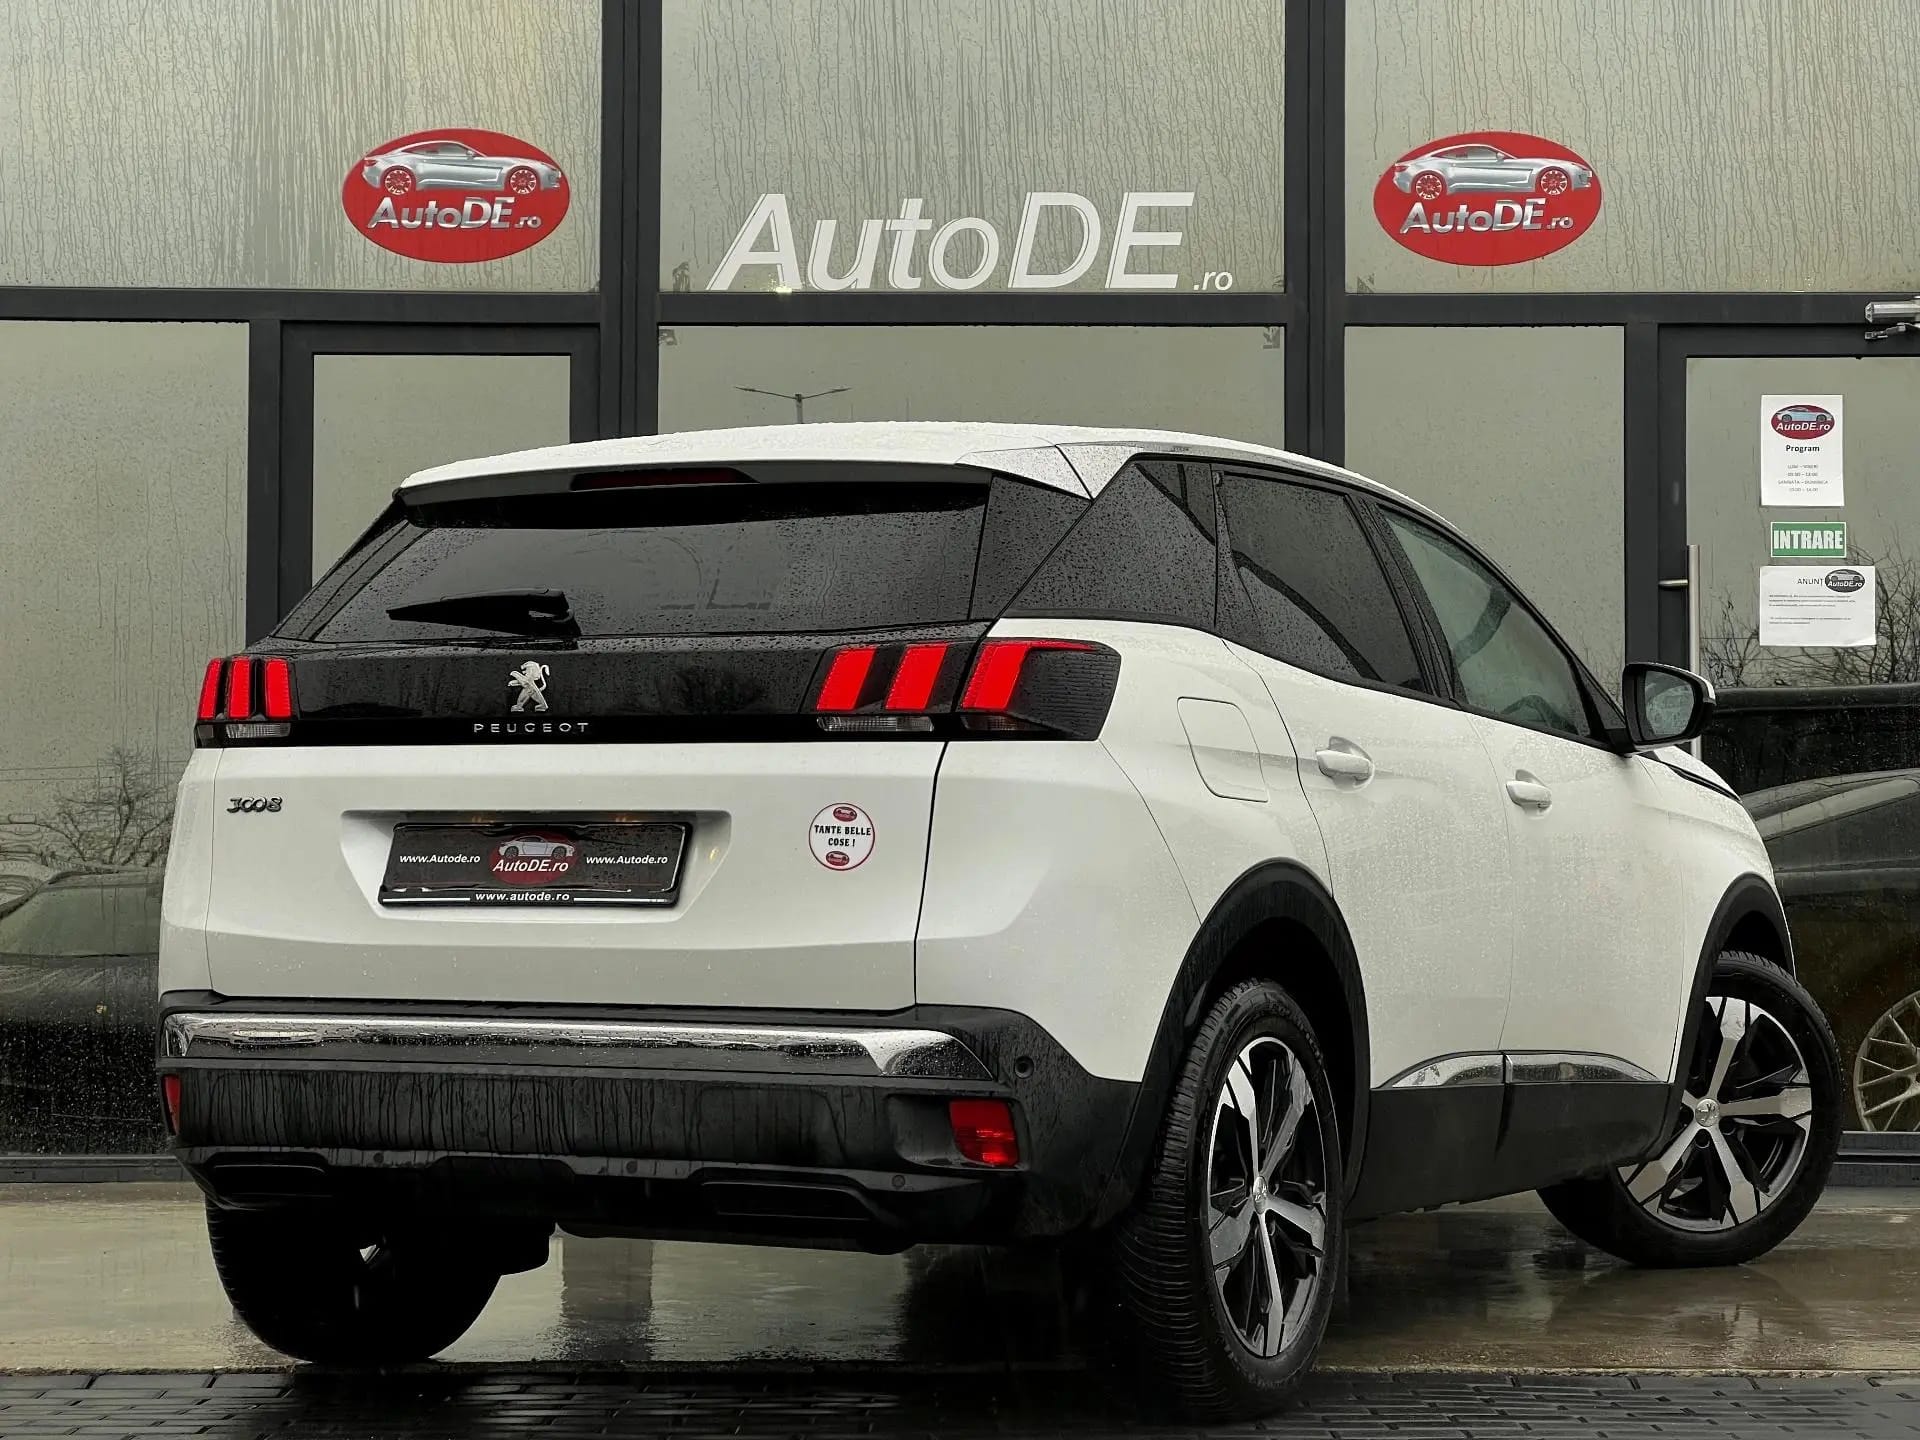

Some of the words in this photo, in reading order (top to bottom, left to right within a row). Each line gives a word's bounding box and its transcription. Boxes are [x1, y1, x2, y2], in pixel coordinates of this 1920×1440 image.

[1775, 421, 1831, 431] AutoDE.ro
[1785, 444, 1820, 453] Program
[1773, 529, 1844, 550] INTRARE
[473, 722, 590, 734] PEUGEOT
[226, 796, 283, 813] 3008
[814, 824, 842, 834] TANTE
[844, 826, 872, 836] BELLE
[828, 837, 850, 847] COSE
[399, 853, 481, 864] www.Autode.ro
[586, 853, 668, 865] www.Autode.ro
[492, 858, 569, 873] AutoDE.ro
[475, 891, 570, 902] www.autode.ro
